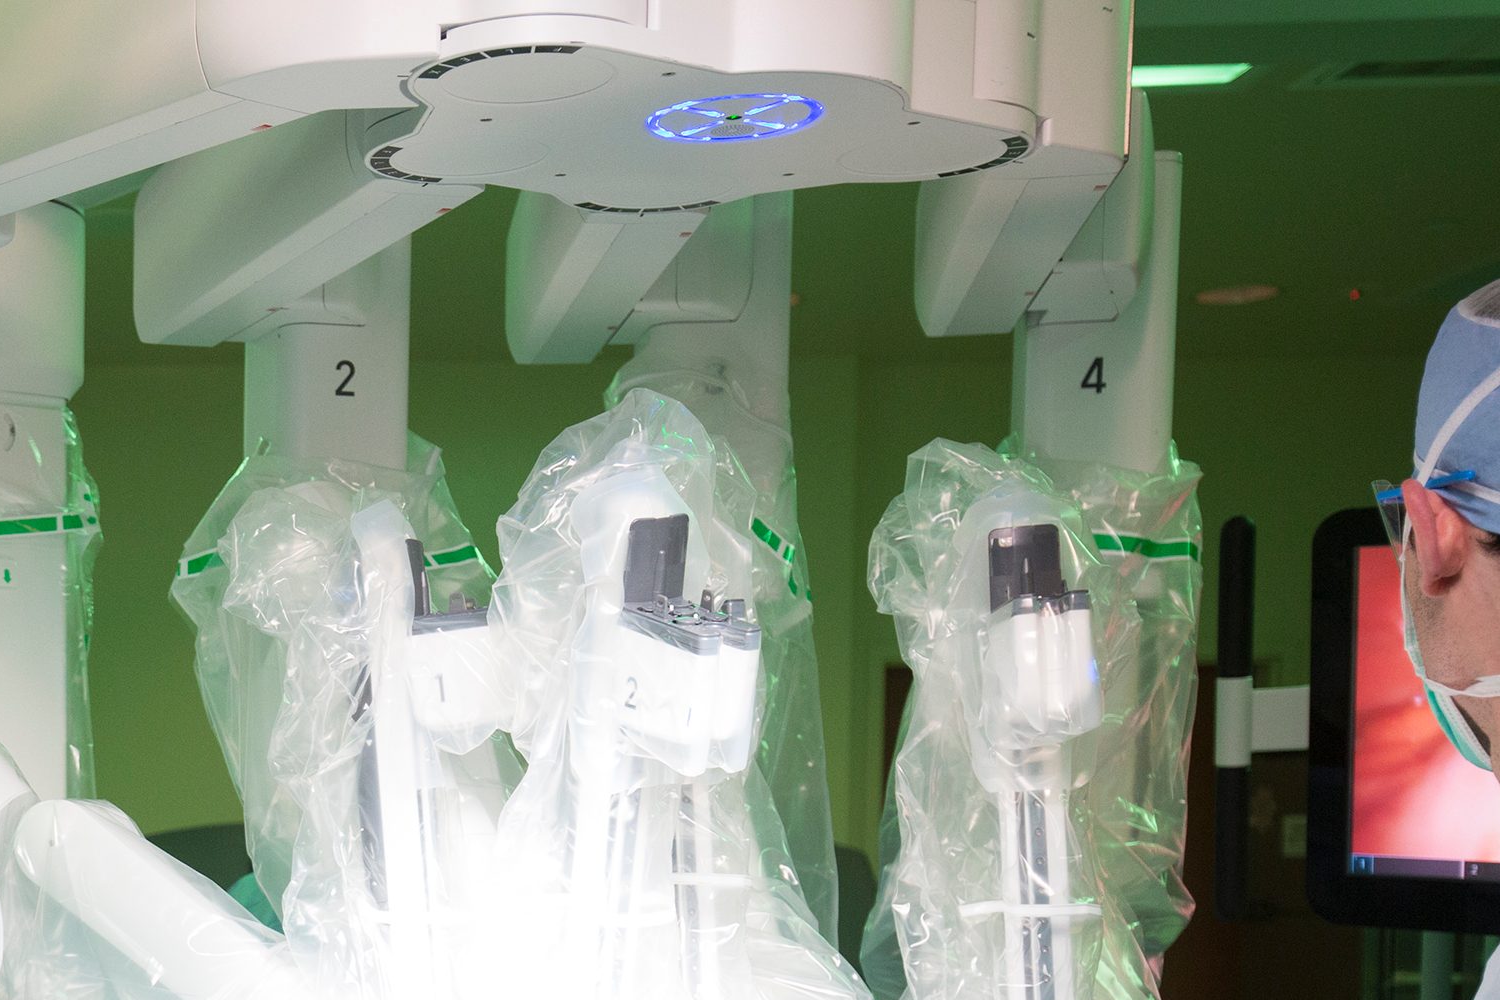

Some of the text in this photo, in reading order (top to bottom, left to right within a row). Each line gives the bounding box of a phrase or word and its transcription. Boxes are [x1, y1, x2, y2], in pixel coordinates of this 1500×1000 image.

[335, 360, 355, 396] 2
[1081, 357, 1107, 394] 4
[434, 673, 445, 703] 1
[624, 676, 638, 710] 2
